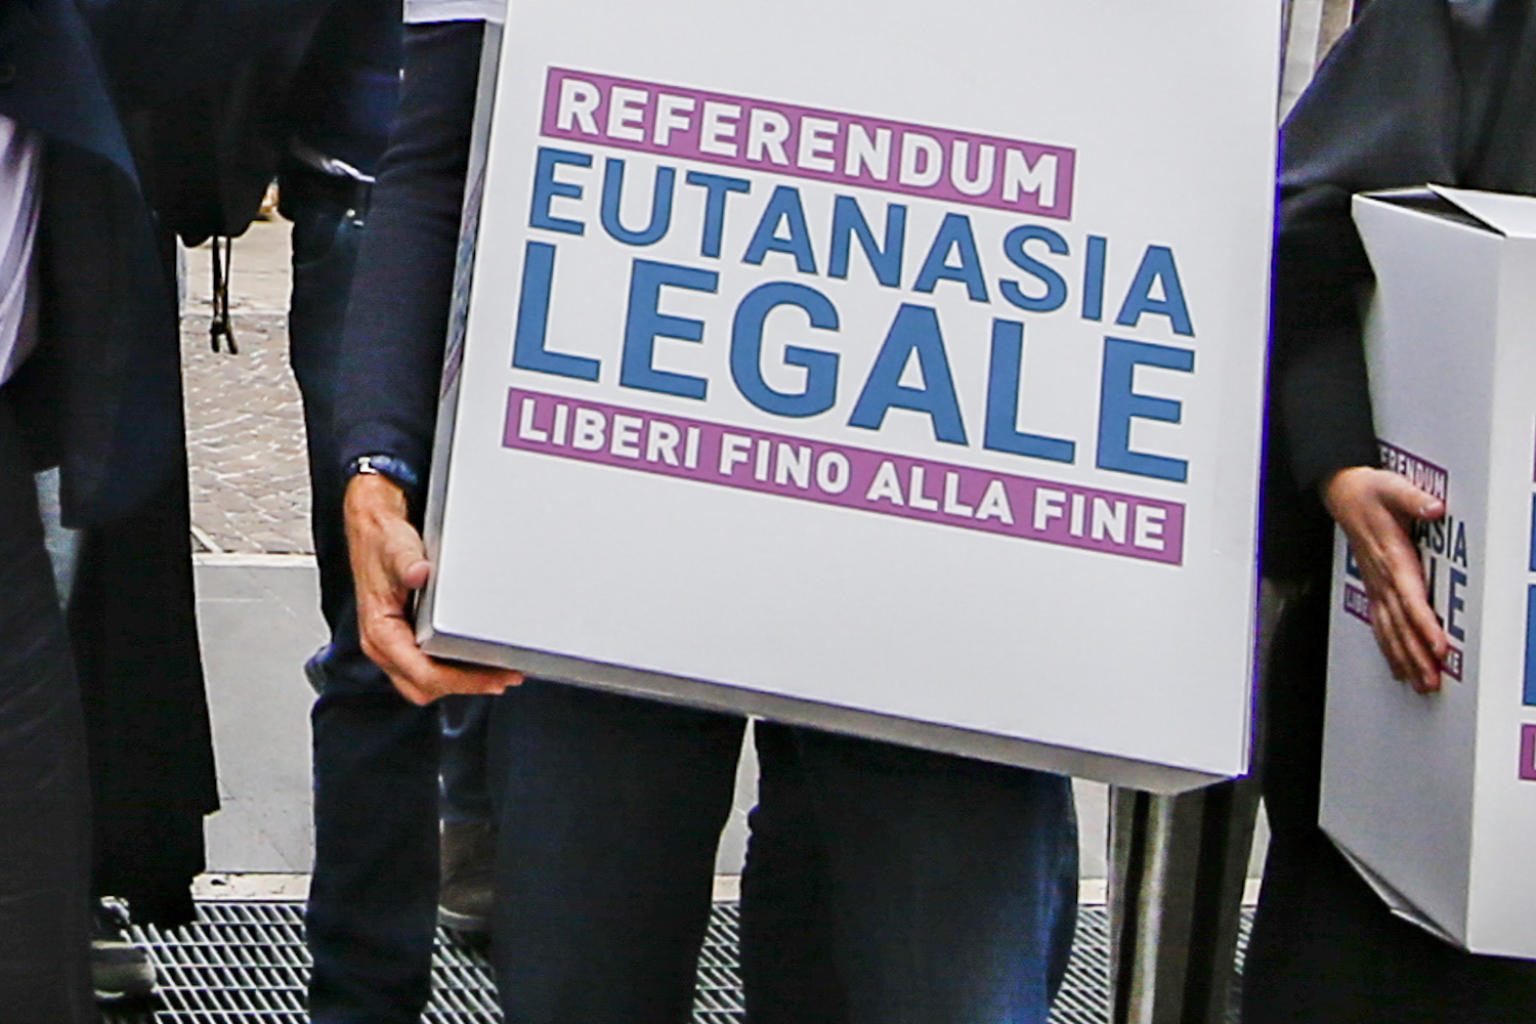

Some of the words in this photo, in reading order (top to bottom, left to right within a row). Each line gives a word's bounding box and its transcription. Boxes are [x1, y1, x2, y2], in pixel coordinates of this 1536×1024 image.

[556, 78, 1059, 209] REFERENDUM
[527, 145, 1196, 338] EUTANASIA
[511, 240, 1196, 485] LEGALE
[519, 399, 700, 471] LIBERI
[718, 432, 852, 496] FINO
[866, 460, 1015, 526] ALLA
[1033, 488, 1169, 552] FINE
